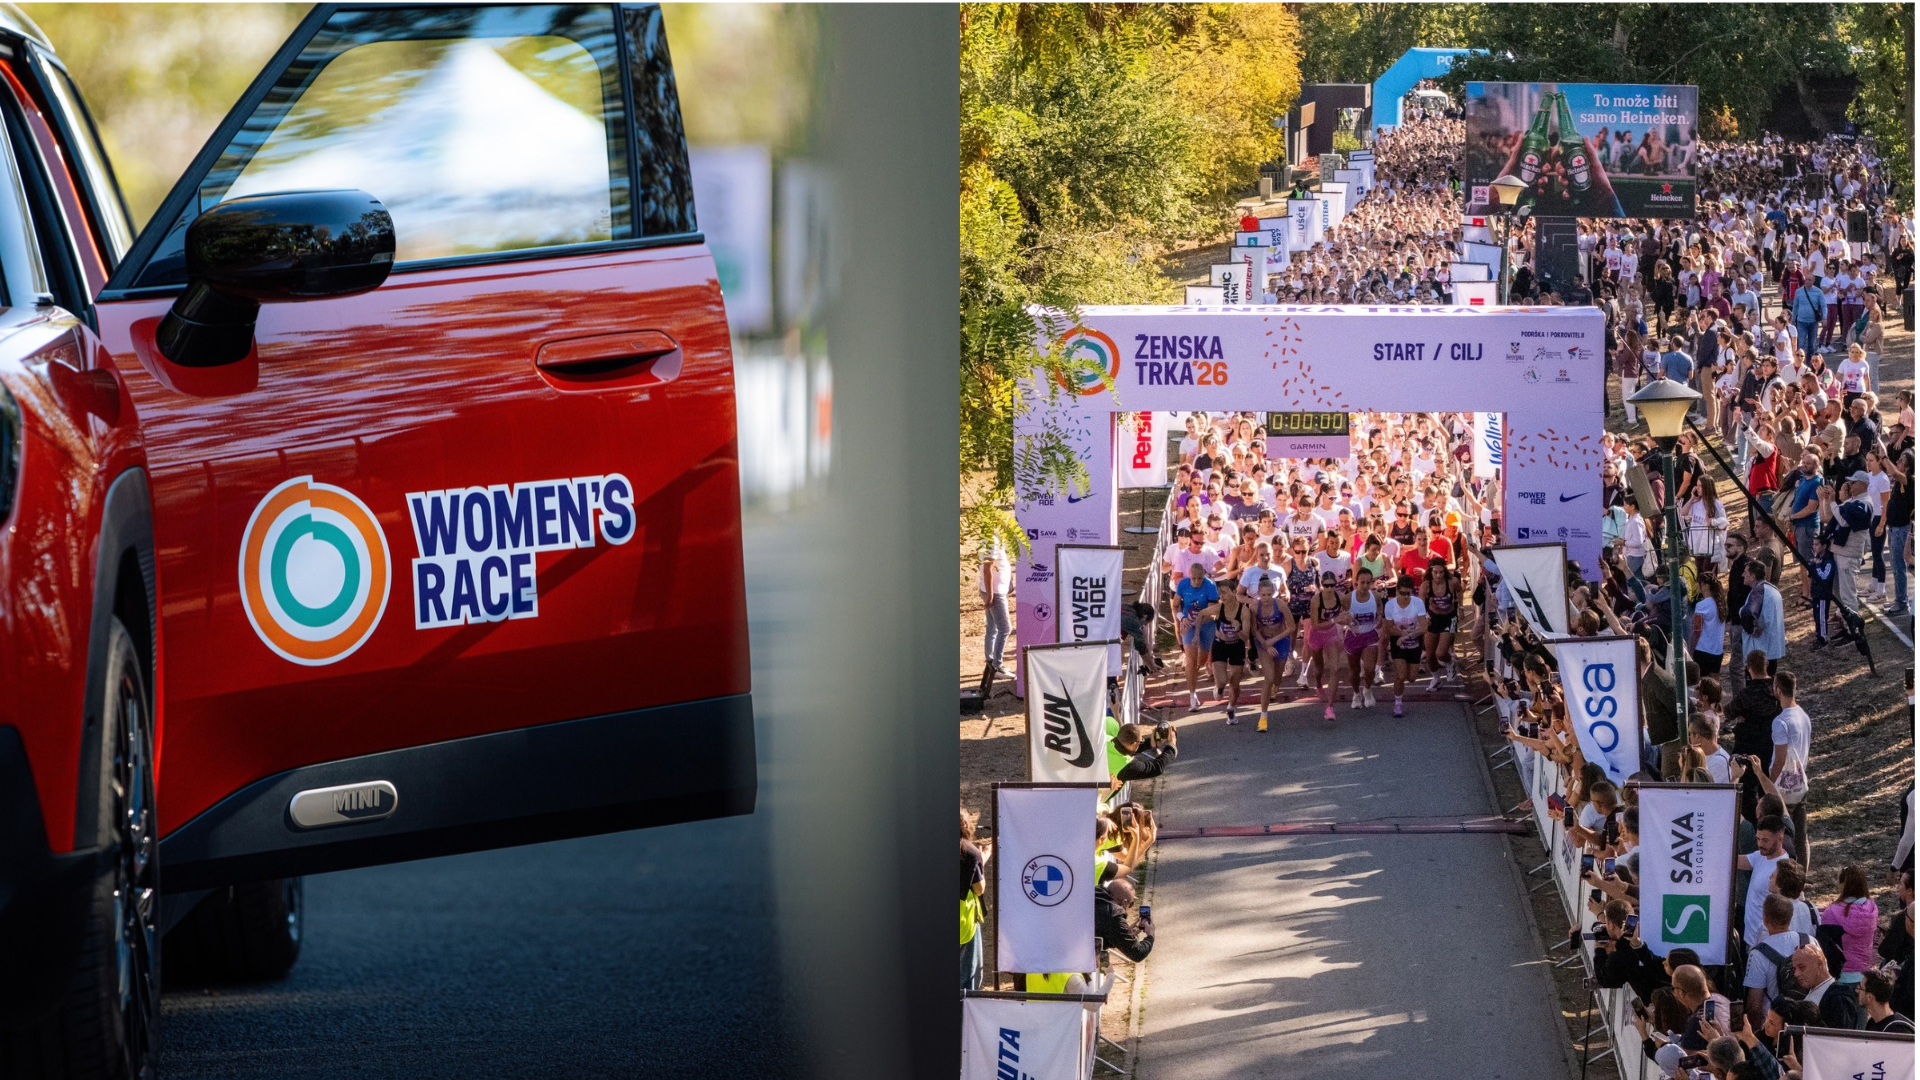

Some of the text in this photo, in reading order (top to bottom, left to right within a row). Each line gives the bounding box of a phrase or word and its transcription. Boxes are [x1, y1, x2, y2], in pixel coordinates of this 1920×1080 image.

[1593, 94, 1678, 108] To može biti
[1580, 112, 1690, 125] samo Heineken.
[1650, 194, 1683, 202] Heineken
[1296, 206, 1306, 230] UŠĆE
[1135, 334, 1223, 359] ŽENSKA
[1521, 330, 1545, 338] PODRŠKA
[1373, 343, 1483, 360] START / CILJ
[1273, 413, 1343, 430] 0:00:00
[1132, 411, 1152, 469] Persil
[1518, 491, 1546, 499] POWER
[411, 479, 632, 557] WOMEN'S
[417, 553, 533, 623] RACE
[1090, 577, 1106, 618] ADE
[1043, 692, 1072, 755] RUN
[1583, 663, 1619, 773] osa
[332, 787, 380, 812] MINI
[1670, 812, 1694, 883] SAVA
[1695, 812, 1705, 883] OSIGURANJE
[1024, 861, 1038, 899] BMW
